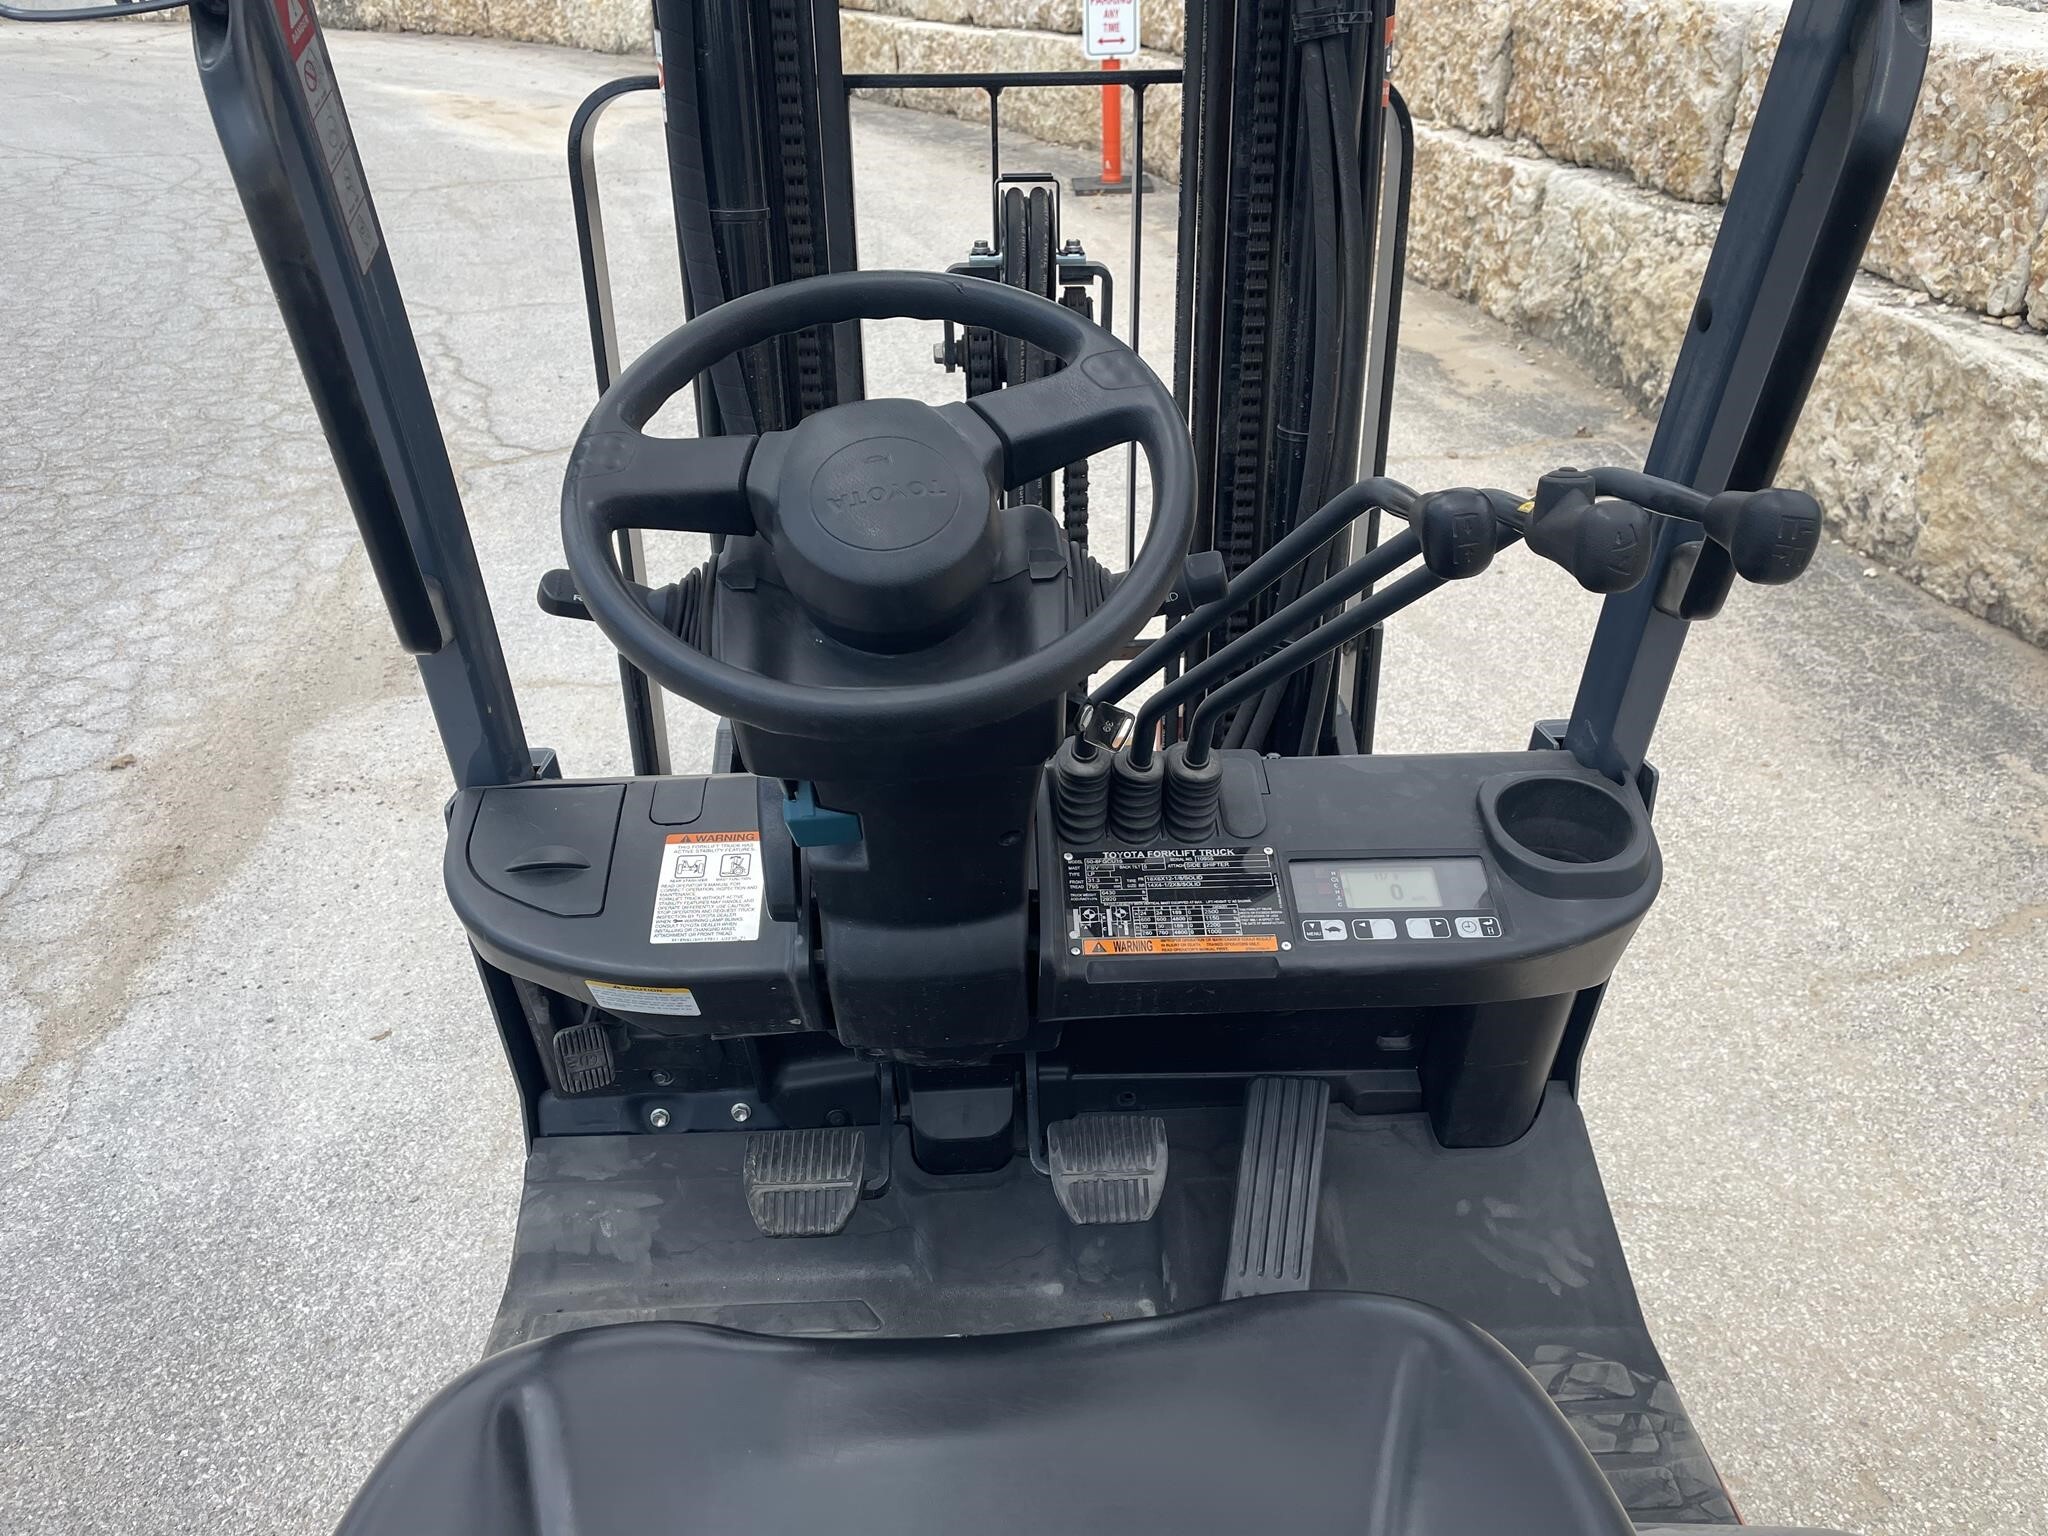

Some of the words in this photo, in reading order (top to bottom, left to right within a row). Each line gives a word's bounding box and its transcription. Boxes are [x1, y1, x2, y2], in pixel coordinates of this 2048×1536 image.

[1104, 9, 1119, 18] ANY
[1104, 22, 1120, 32] TIME
[826, 479, 947, 509] TOYOTA
[695, 833, 755, 842] WARNING
[1147, 850, 1198, 858] FORKLIFT
[1112, 941, 1153, 952] WARNING
